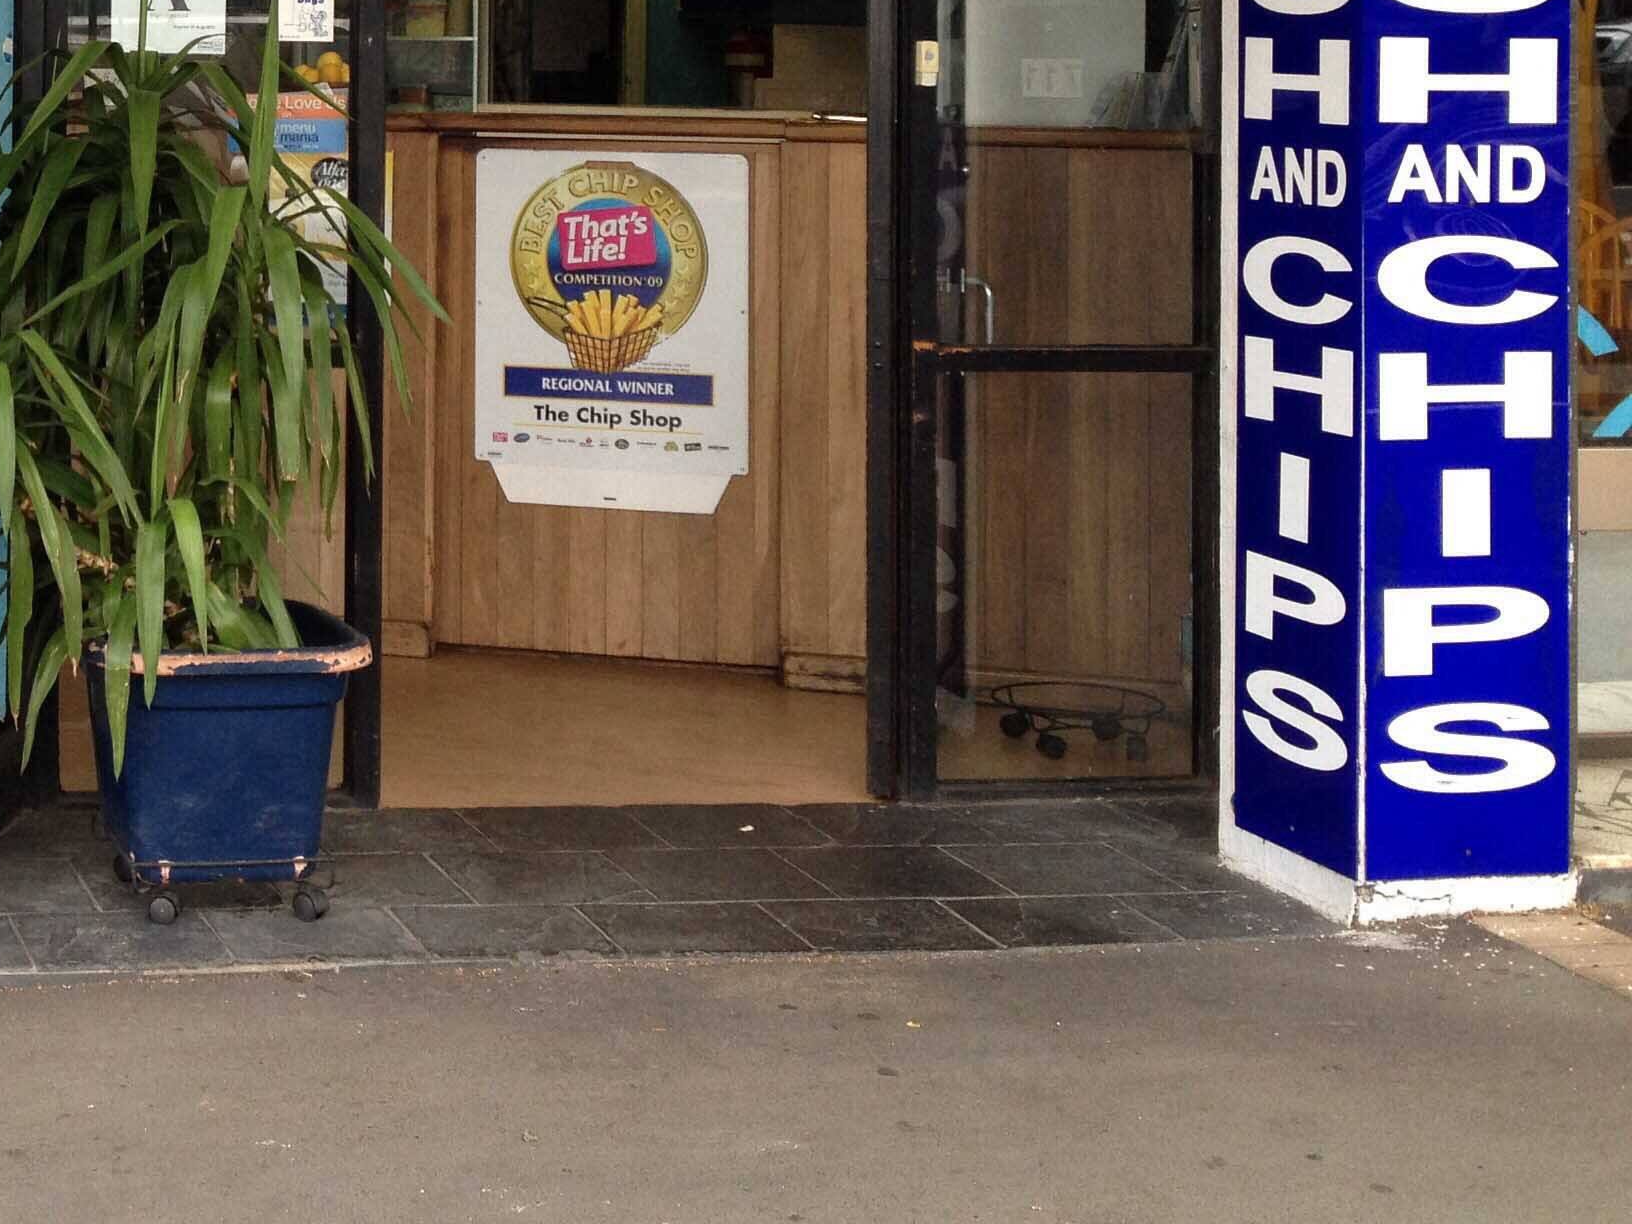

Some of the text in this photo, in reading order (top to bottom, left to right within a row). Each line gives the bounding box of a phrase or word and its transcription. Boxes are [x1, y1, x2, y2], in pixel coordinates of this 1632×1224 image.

[285, 95, 322, 110] Love
[279, 122, 316, 134] menu
[279, 132, 319, 143] mania
[1250, 146, 1347, 209] AND
[1387, 143, 1546, 204] AND
[520, 172, 699, 260] BEST CHIP SHOP
[564, 212, 648, 240] That's
[568, 236, 628, 265] Life!
[554, 273, 642, 287] COMPETITION
[542, 377, 674, 396] REGIONAL WINNER
[534, 405, 682, 432] The Chip Shop
[1241, 234, 1355, 773] CHIPS
[1377, 233, 1560, 795] CHIPS
